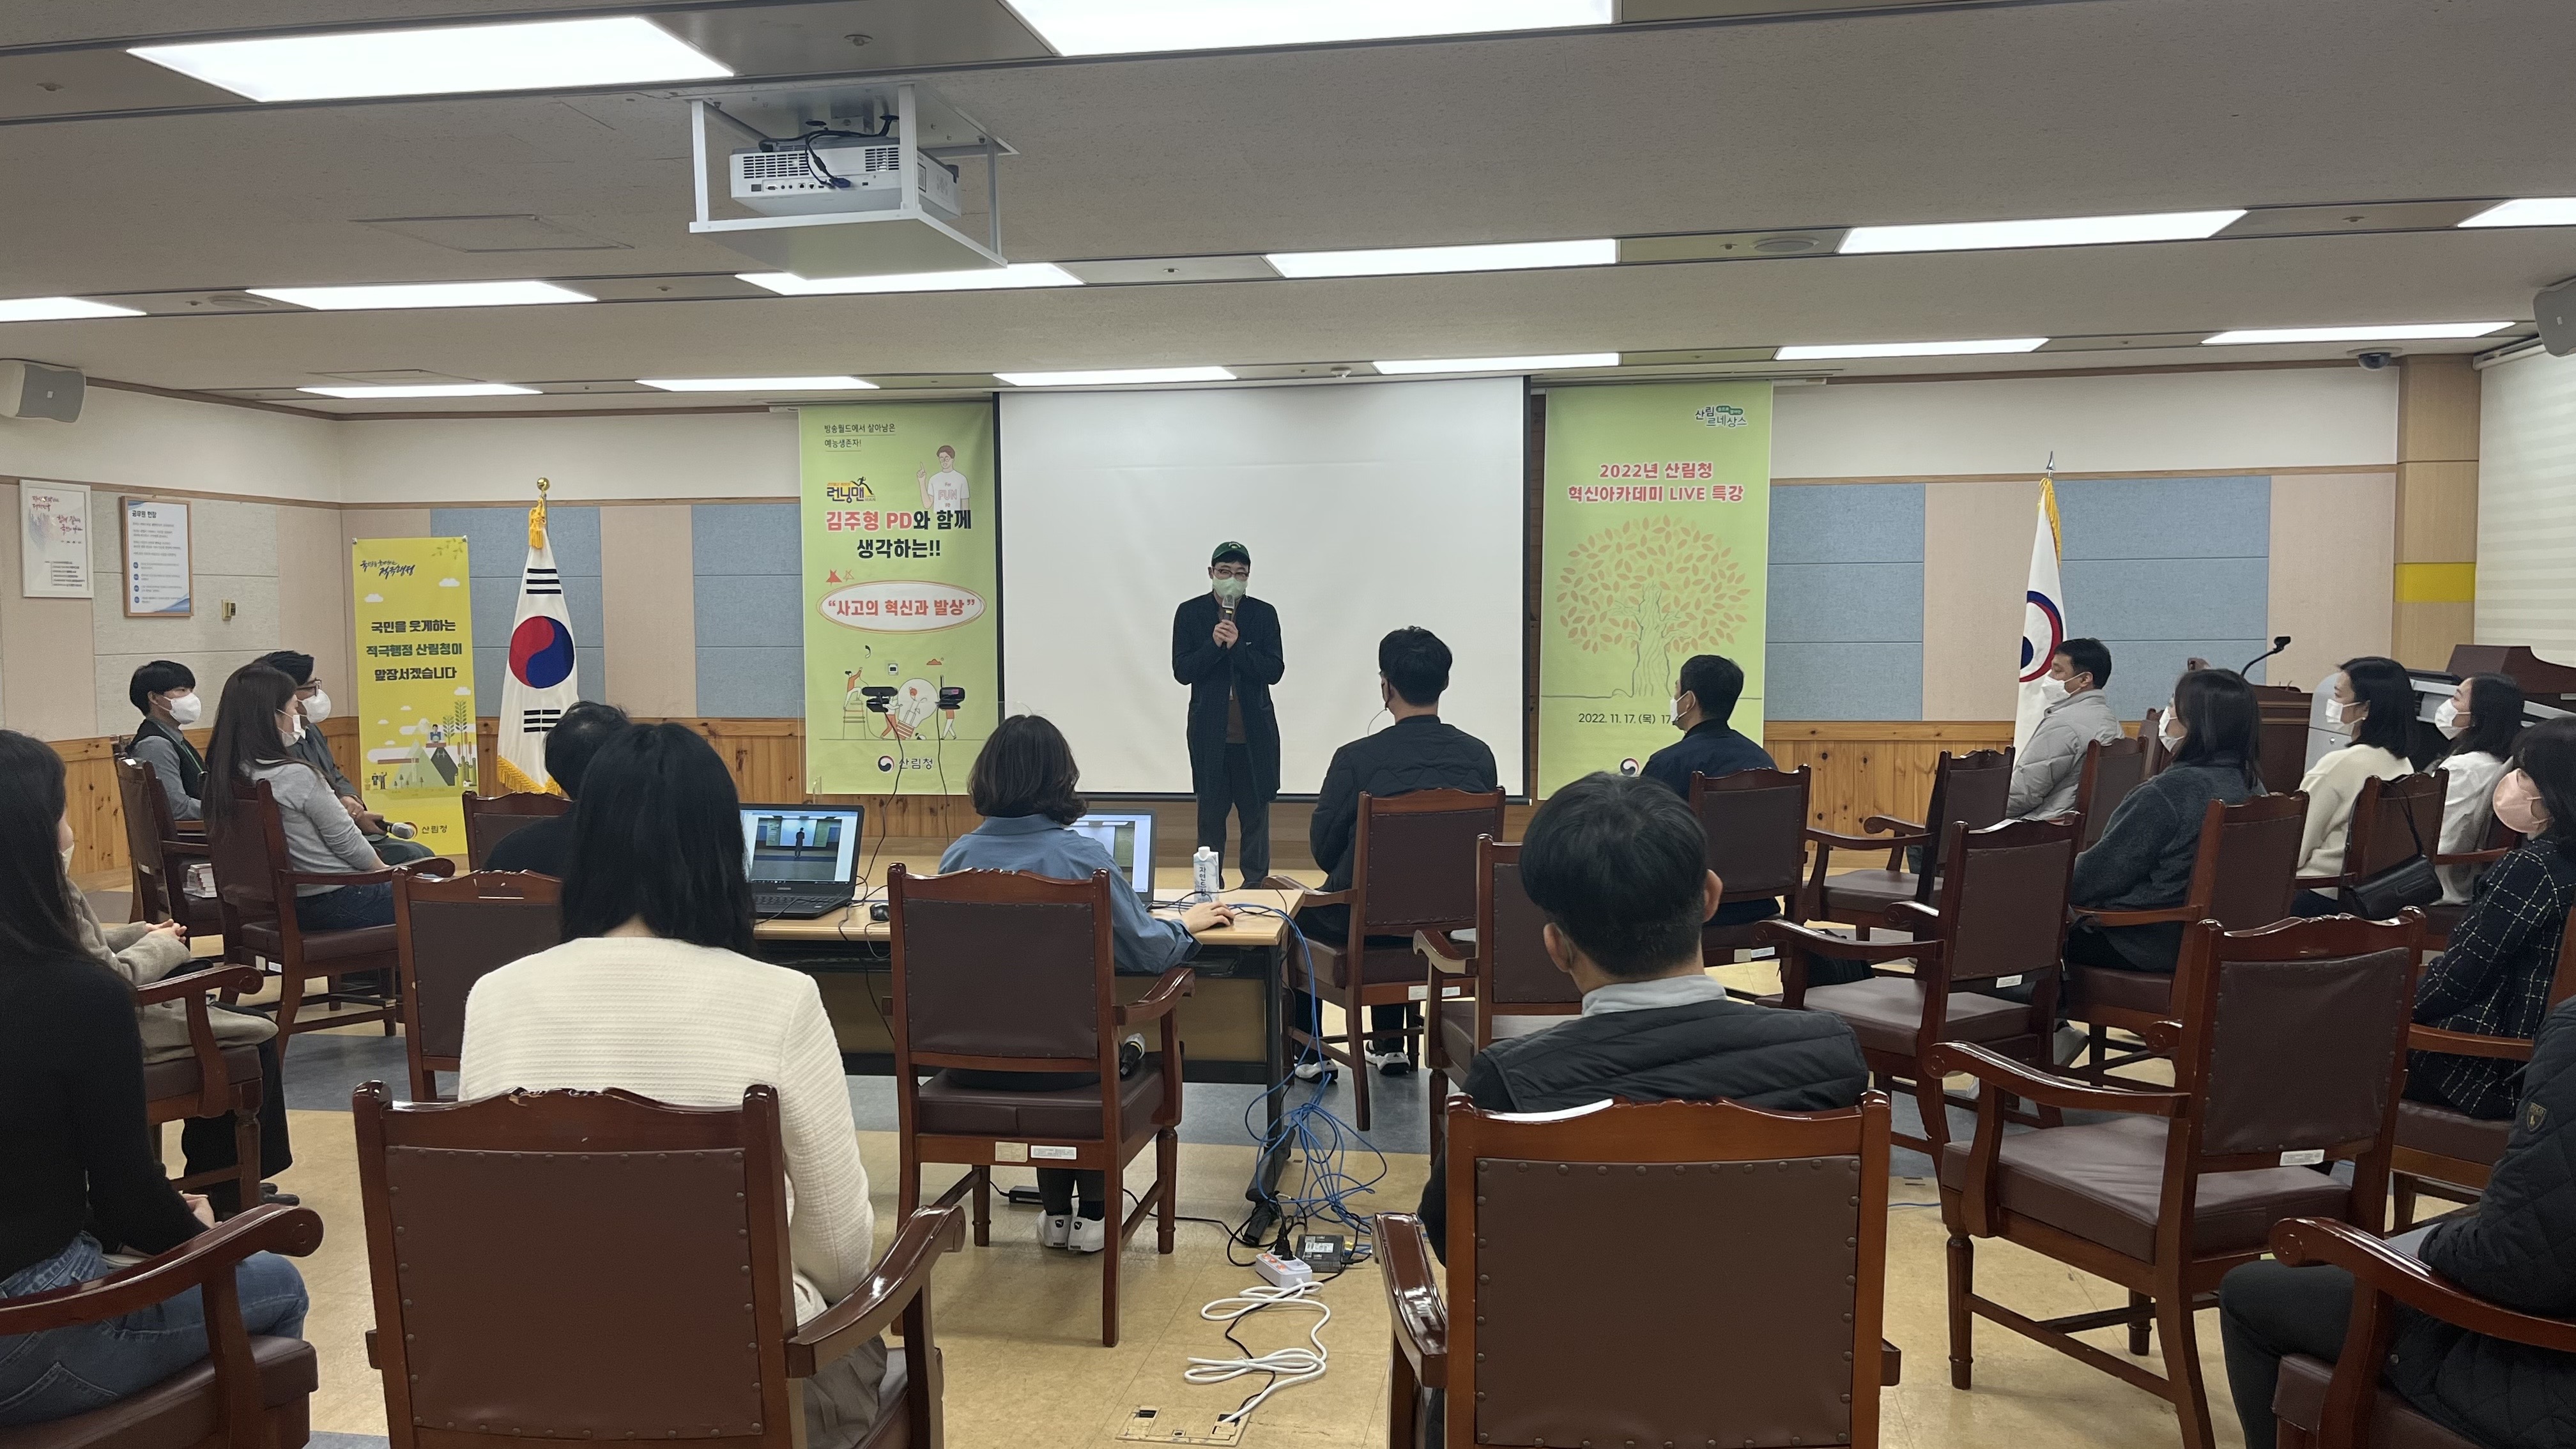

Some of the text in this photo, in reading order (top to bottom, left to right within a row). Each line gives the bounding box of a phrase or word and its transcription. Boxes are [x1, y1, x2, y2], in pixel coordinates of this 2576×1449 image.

[1695, 406, 1714, 420] 산림
[1706, 415, 1747, 427] 르네상스
[868, 424, 896, 433] 살아남은
[824, 439, 862, 448] 예능생존자!
[1599, 463, 1712, 479] 2022년 산림청
[827, 487, 864, 503] 런닝맨
[939, 489, 958, 500] FUN
[1568, 486, 1744, 502] 혁신아카데미 LIVE 특강
[826, 510, 972, 531] 김주형 PD와 함께
[857, 539, 940, 558] 생각하는!!
[885, 599, 929, 616] 혁신과
[371, 620, 456, 633] 국민을 웃게하는
[366, 643, 463, 657] 적극행정 산림청이
[374, 667, 457, 682] 앞장서겠습니다
[1578, 714, 1607, 723] 2022.
[1611, 714, 1621, 724] 11.
[899, 758, 933, 769] 산림청
[422, 825, 448, 834] 산림청
